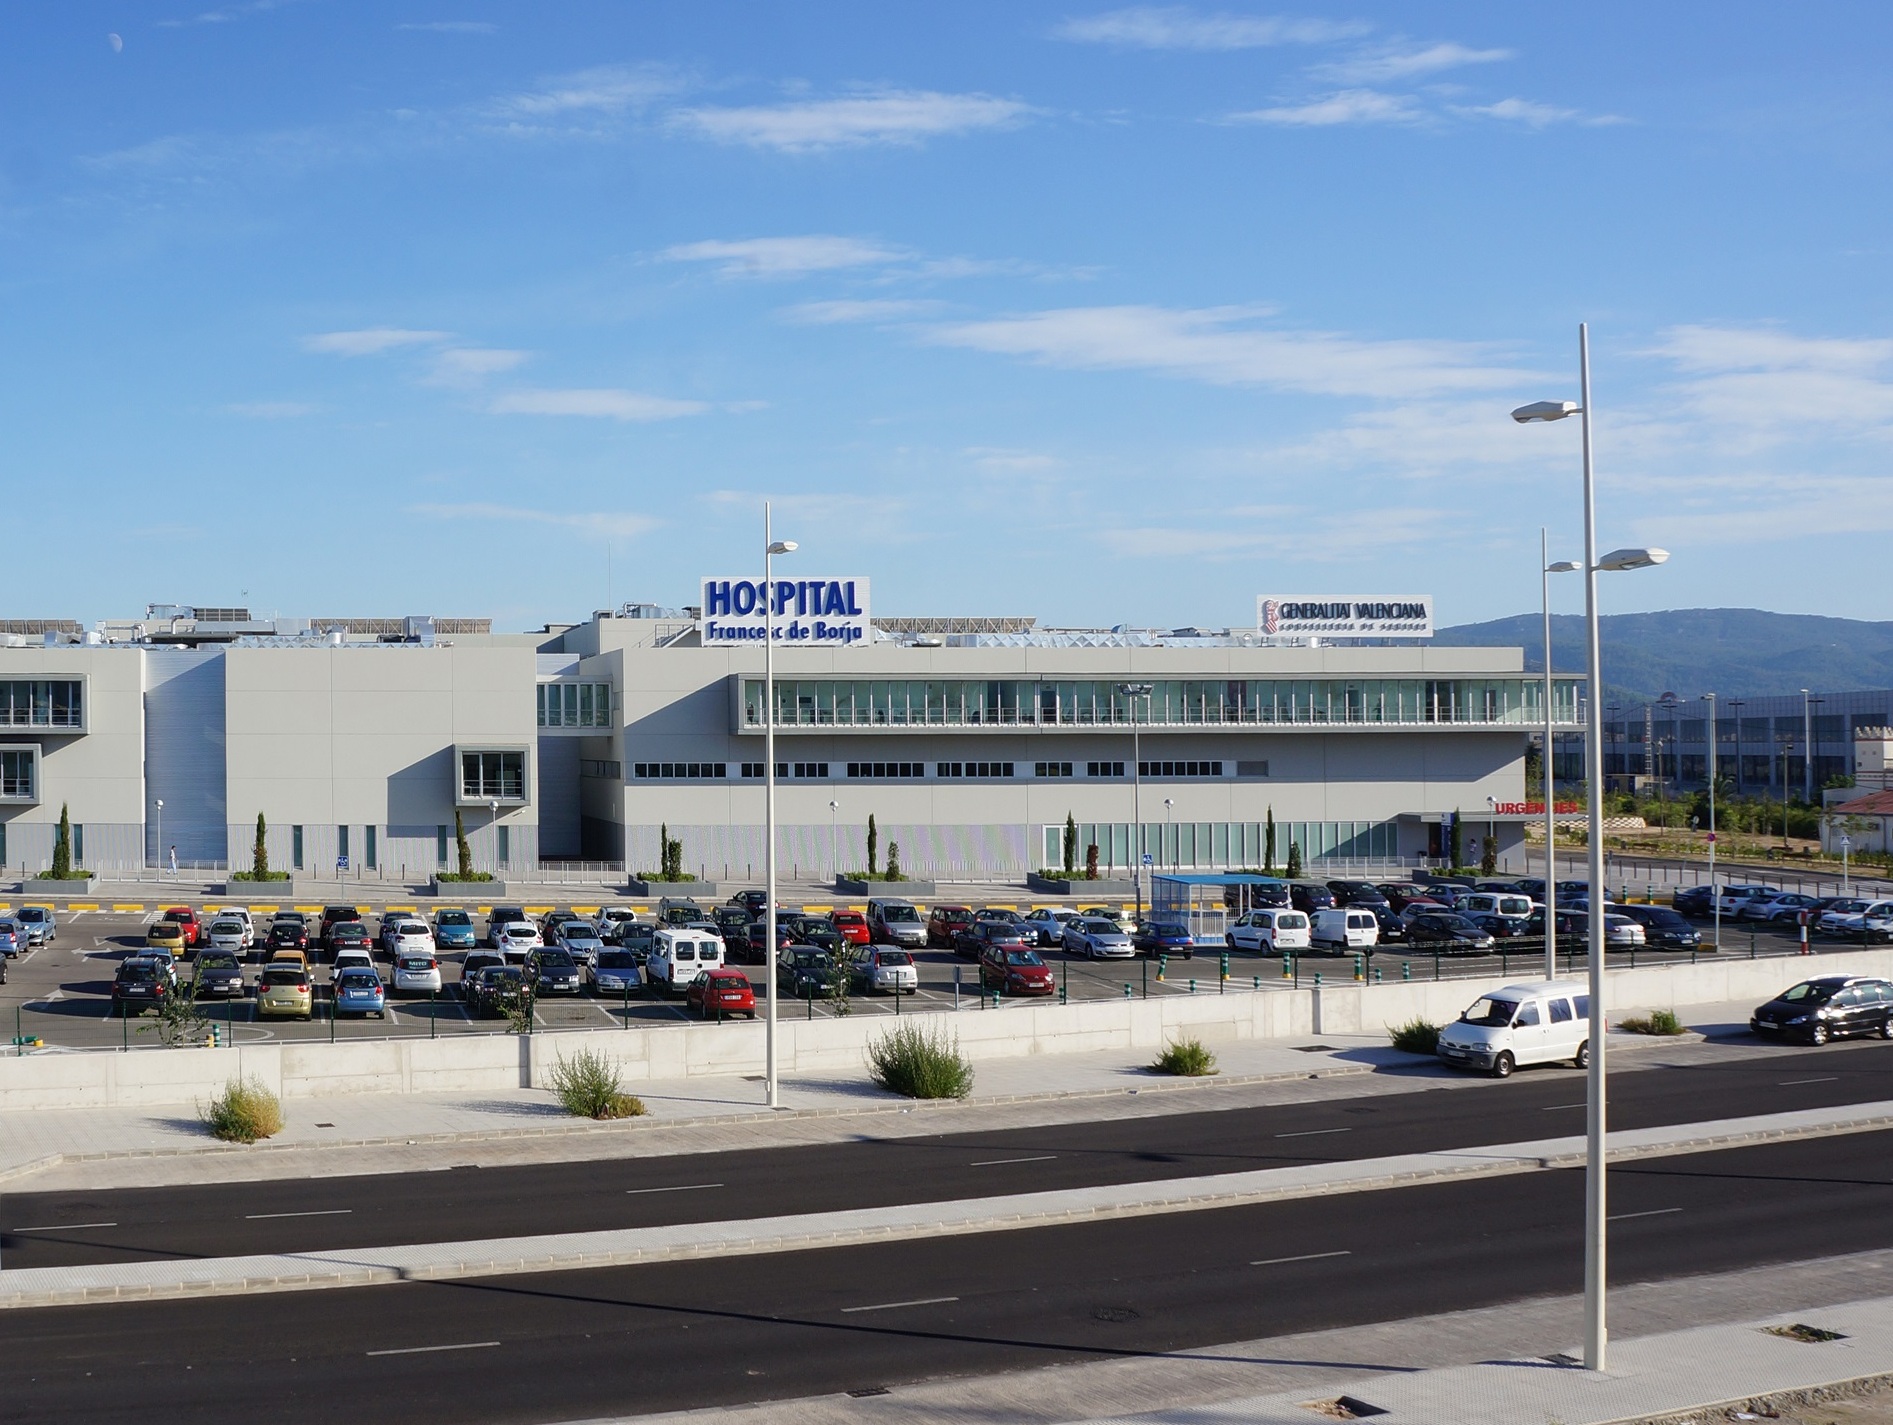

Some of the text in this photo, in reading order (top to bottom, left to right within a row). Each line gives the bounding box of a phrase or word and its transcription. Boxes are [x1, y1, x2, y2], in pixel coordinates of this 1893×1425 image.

[708, 581, 862, 616] HOSPITAL
[1281, 602, 1427, 619] GENERALITAT VALENCIANA
[787, 620, 810, 640] de
[814, 621, 862, 643] Borja
[1495, 800, 1577, 815] URGÈNIES
